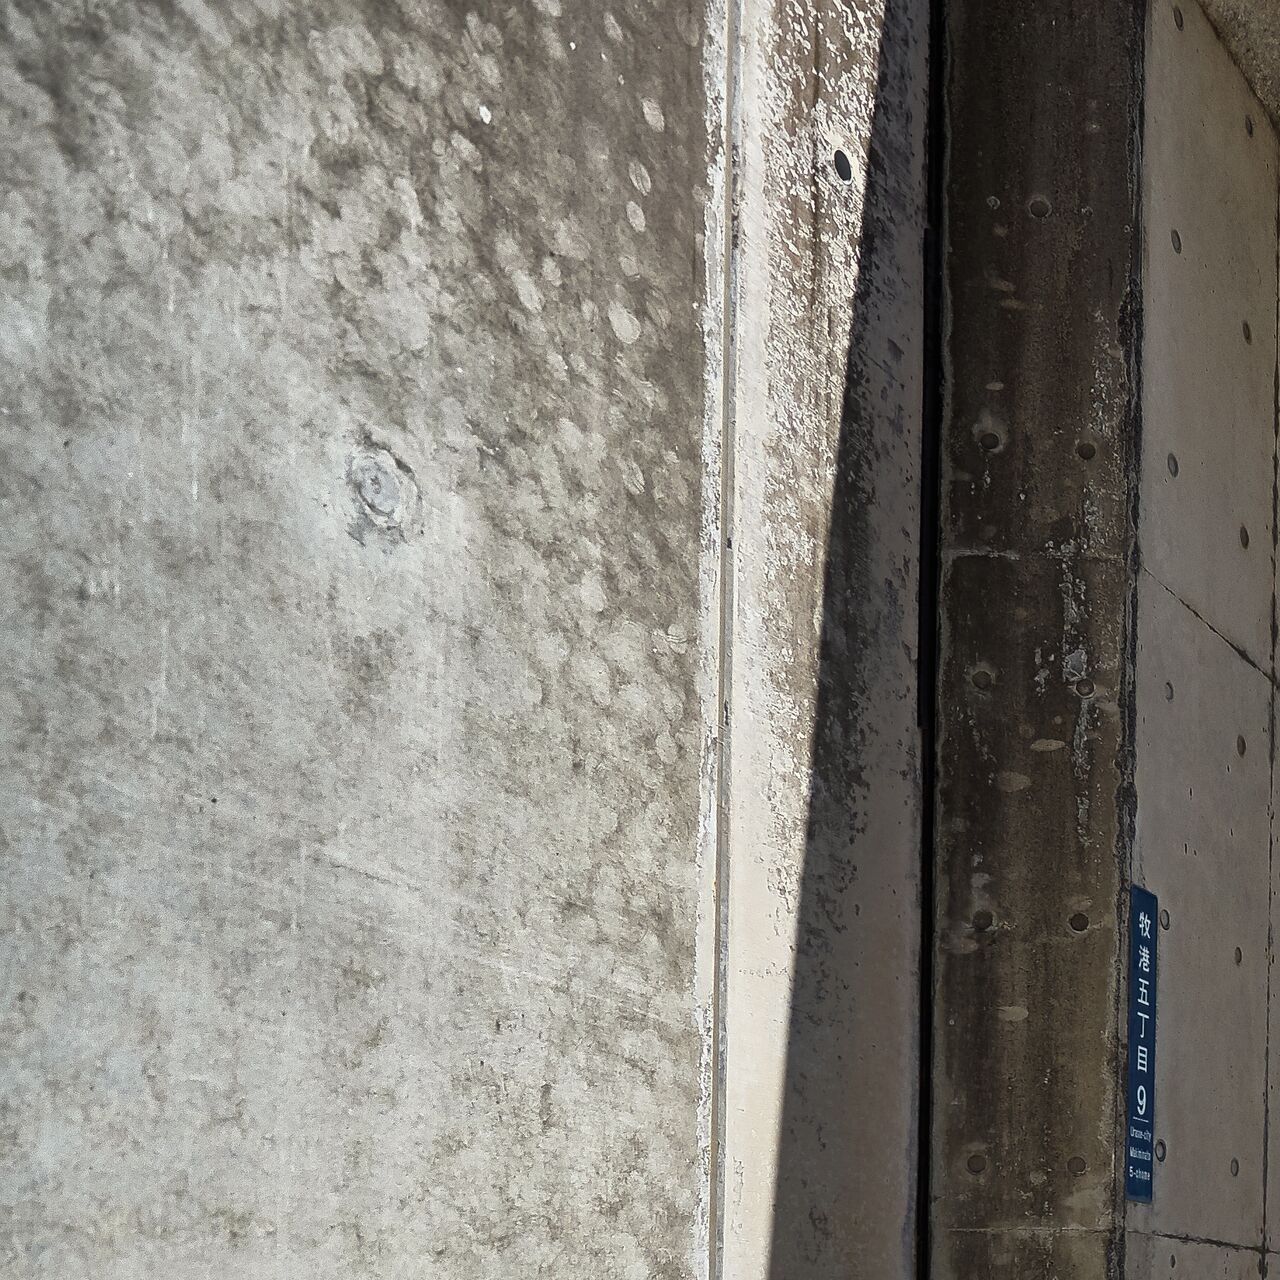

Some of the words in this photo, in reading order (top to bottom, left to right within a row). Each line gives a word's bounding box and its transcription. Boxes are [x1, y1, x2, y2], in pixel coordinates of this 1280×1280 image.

[1137, 911, 1152, 1072] 牧港五丁目
[1137, 1085, 1147, 1115] 9
